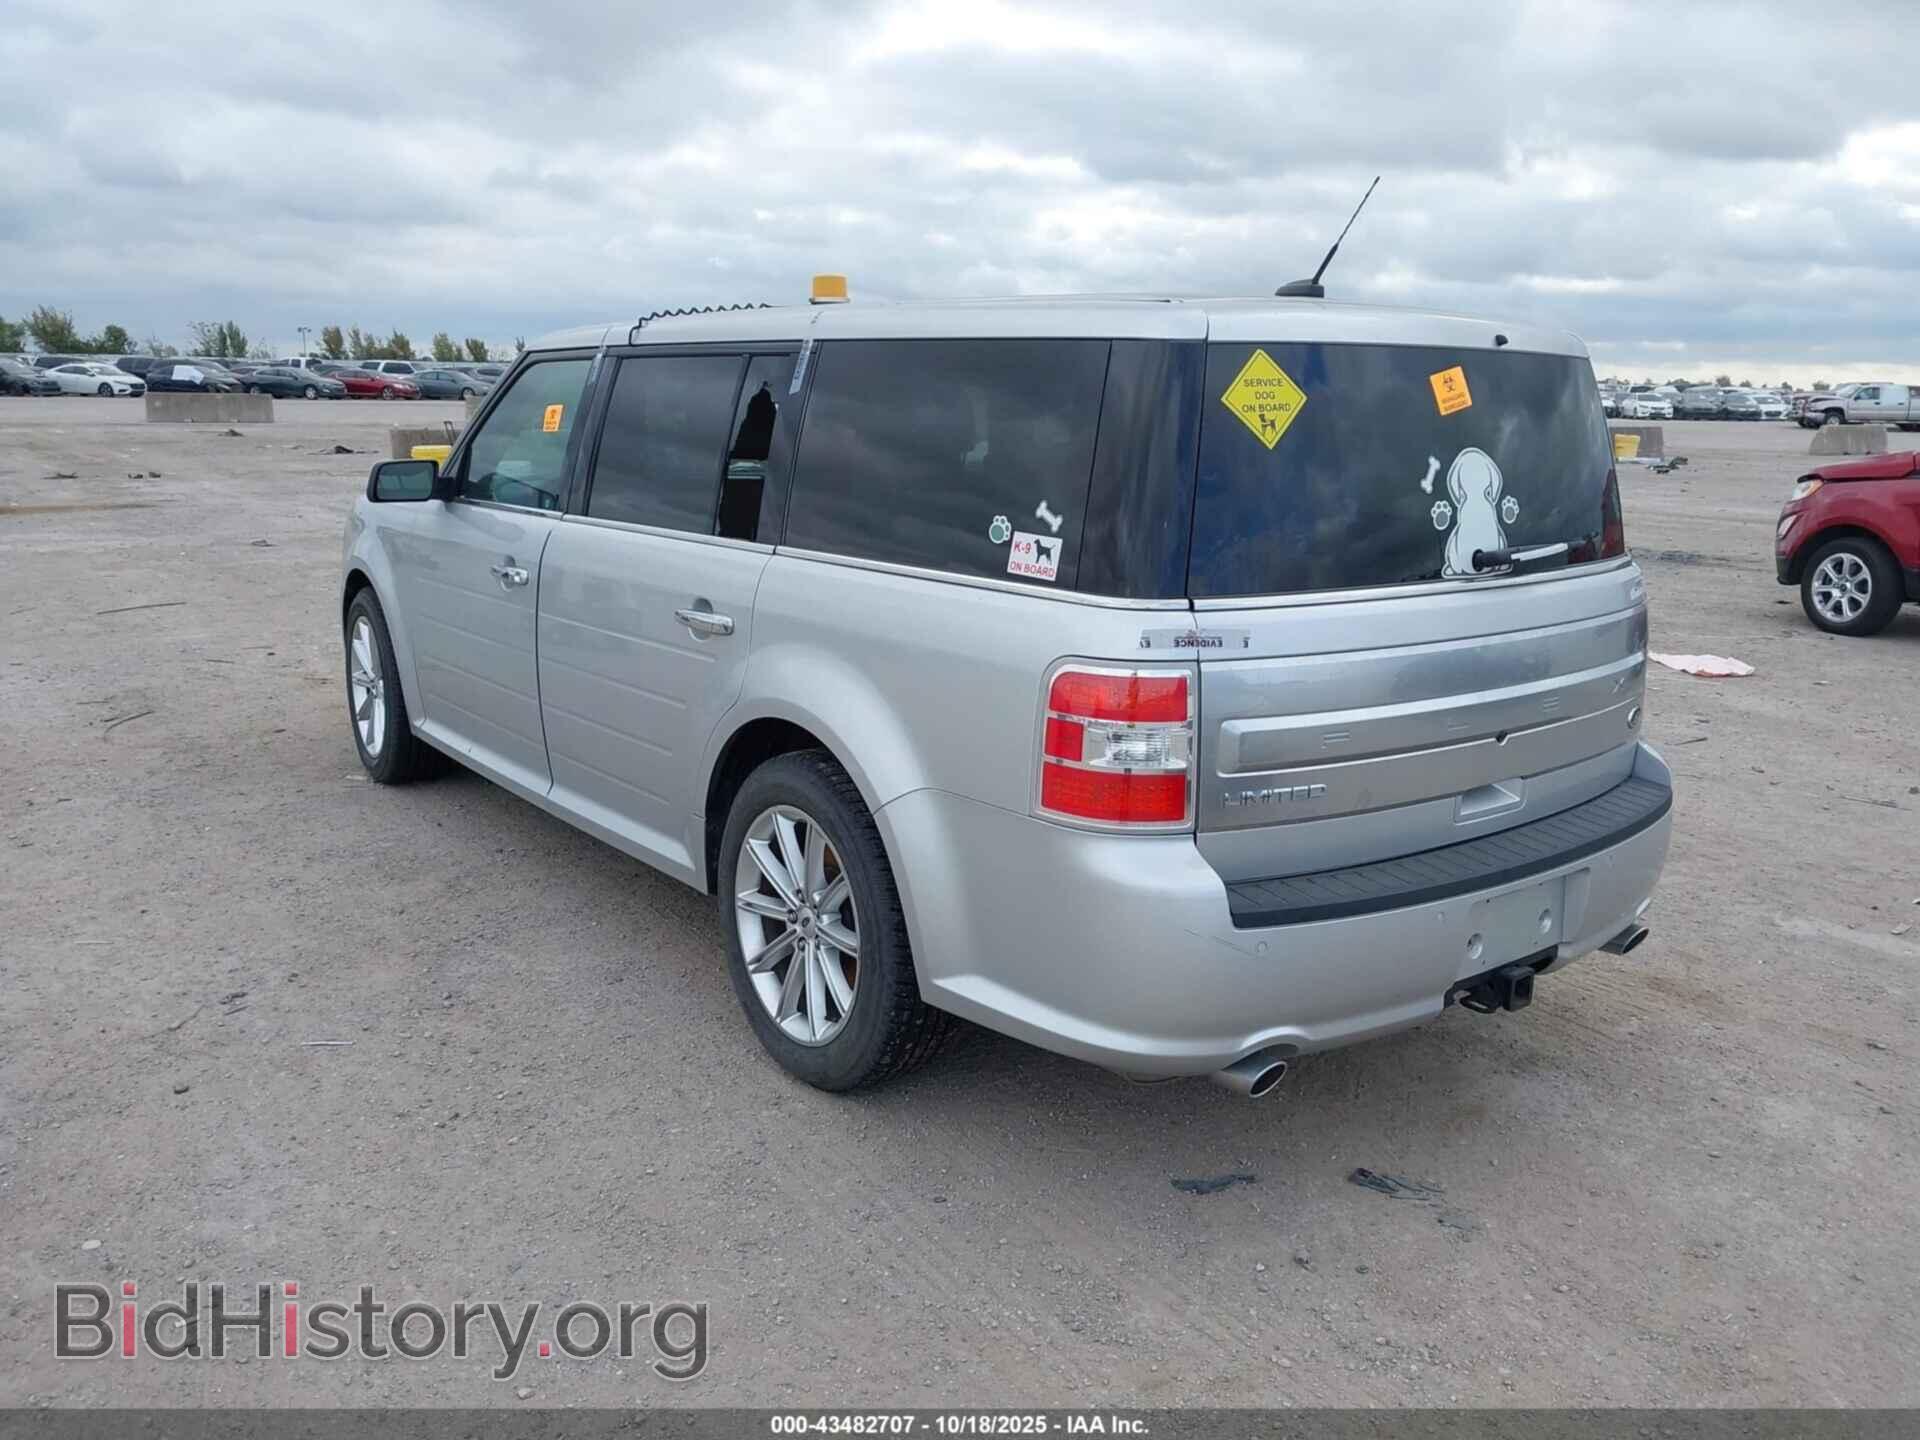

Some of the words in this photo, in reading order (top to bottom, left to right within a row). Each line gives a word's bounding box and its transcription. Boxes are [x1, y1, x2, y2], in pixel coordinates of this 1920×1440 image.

[1243, 377, 1284, 388] SERVICE
[1255, 391, 1275, 400] DOG
[1242, 403, 1256, 413] ON
[1258, 403, 1291, 413] BOARD
[1014, 541, 1032, 554] K-9
[1010, 561, 1022, 572] ON
[1023, 563, 1055, 578] BOARD
[1174, 640, 1223, 648] EVIDENCE
[1222, 784, 1327, 808] LIMITED
